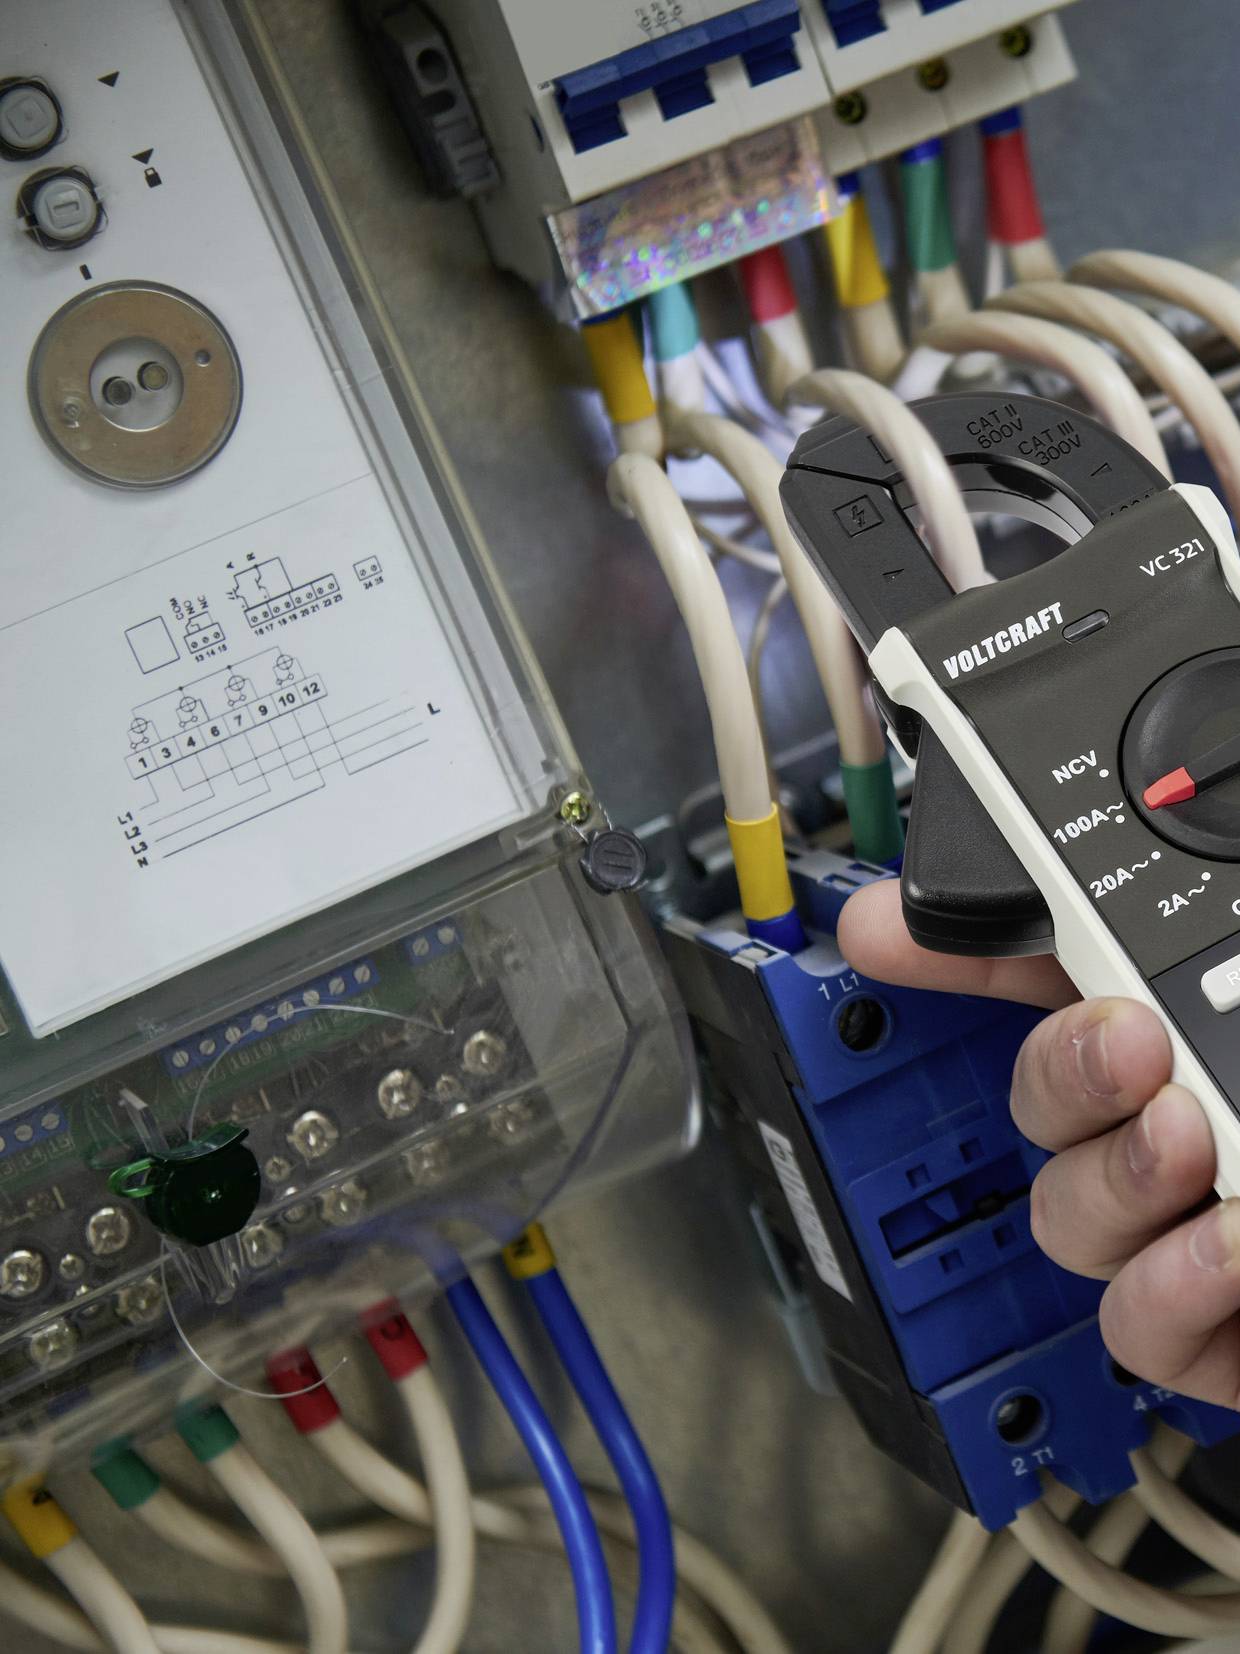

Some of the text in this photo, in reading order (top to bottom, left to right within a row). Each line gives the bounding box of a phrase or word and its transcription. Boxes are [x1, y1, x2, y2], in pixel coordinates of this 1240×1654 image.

[966, 403, 1017, 436] CAT II
[977, 418, 1023, 449] 600V
[1017, 420, 1074, 455] CAT III
[1035, 434, 1081, 465] 300V
[1139, 538, 1205, 576] VC 321
[169, 597, 184, 620] COM
[184, 600, 195, 615] NO
[942, 602, 1064, 680] VOLTCRAFT
[427, 702, 441, 715] L
[138, 682, 321, 768] 1 3 4 6 7 9 10 12
[1051, 750, 1098, 784] NCV
[117, 811, 133, 826] L1
[124, 825, 141, 840] L2
[131, 841, 148, 855] L3
[137, 857, 149, 869] N
[817, 972, 859, 1000] 1 L1
[1011, 1447, 1055, 1476] 2 T1
